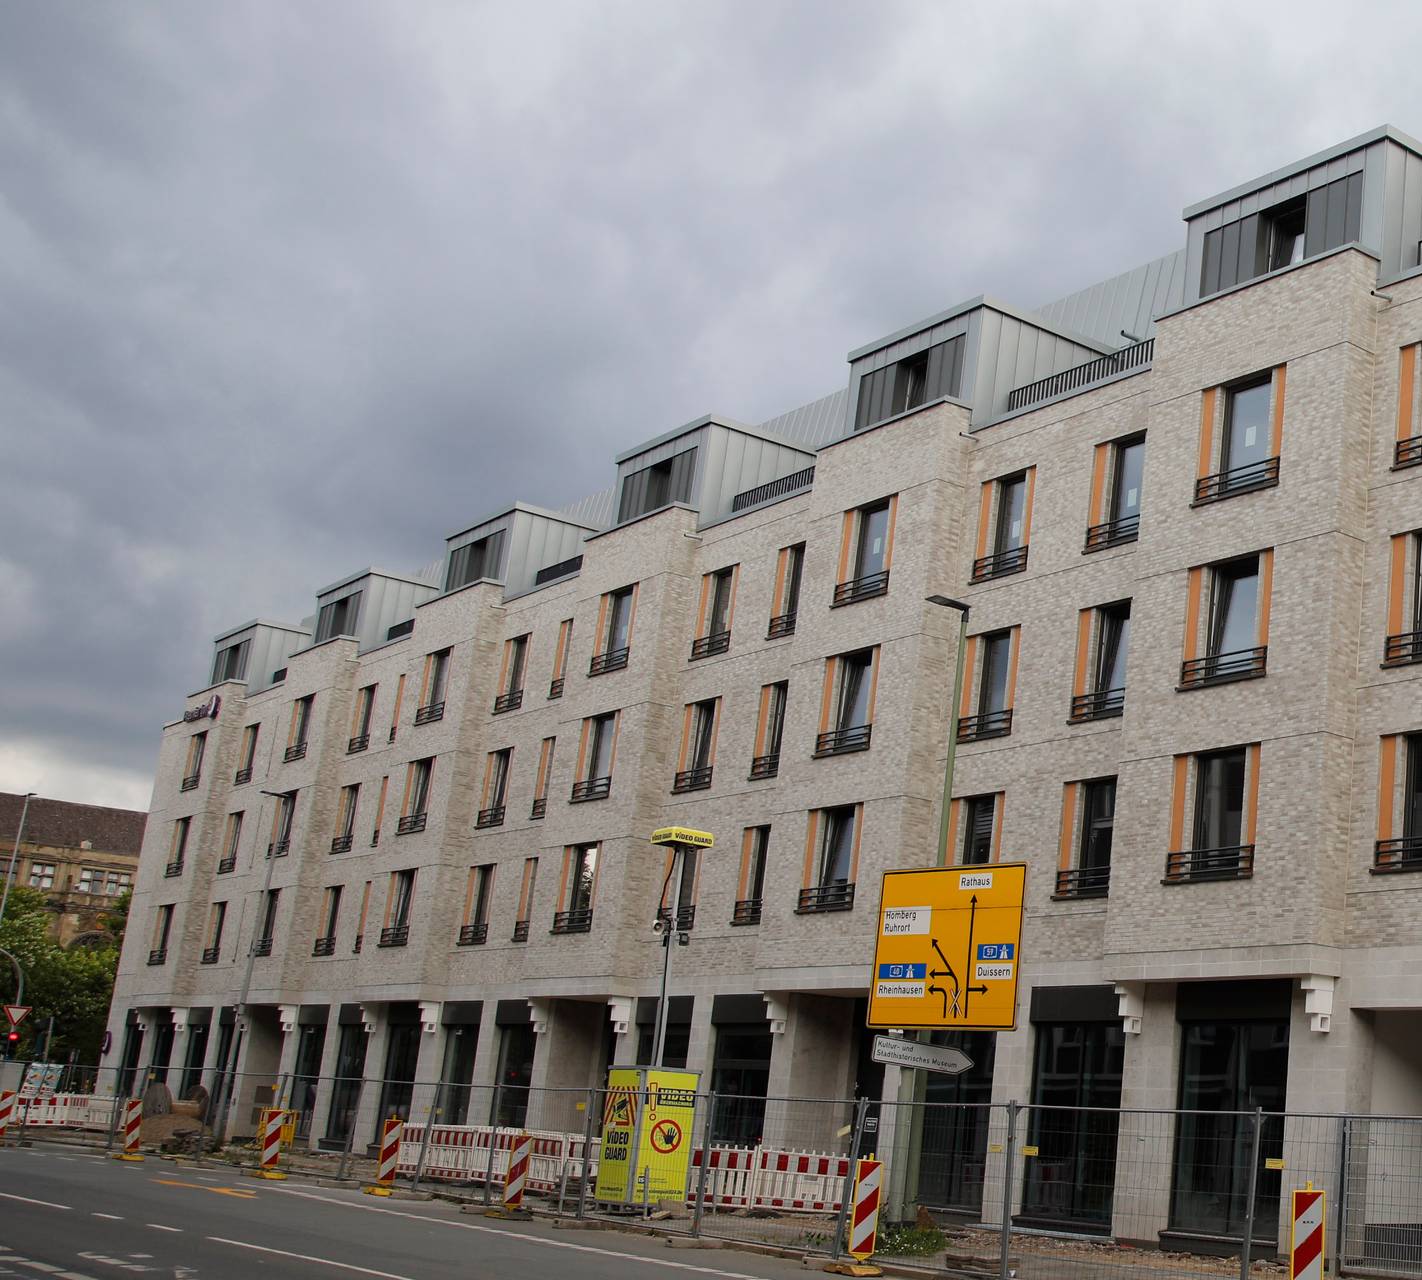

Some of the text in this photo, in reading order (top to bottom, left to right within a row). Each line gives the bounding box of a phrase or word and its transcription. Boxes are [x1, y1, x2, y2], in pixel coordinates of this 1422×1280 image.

[694, 836, 712, 844] GUARD
[961, 877, 990, 887] Rathaus
[886, 911, 917, 921] Homberg
[885, 924, 911, 932] Ruhrort
[977, 966, 1010, 976] Duissern
[878, 985, 923, 994] Rheinhausen
[878, 1041, 900, 1050] Kultur-
[876, 1049, 958, 1068] Stadthistorisches Museum
[605, 1147, 627, 1160] GUARD
